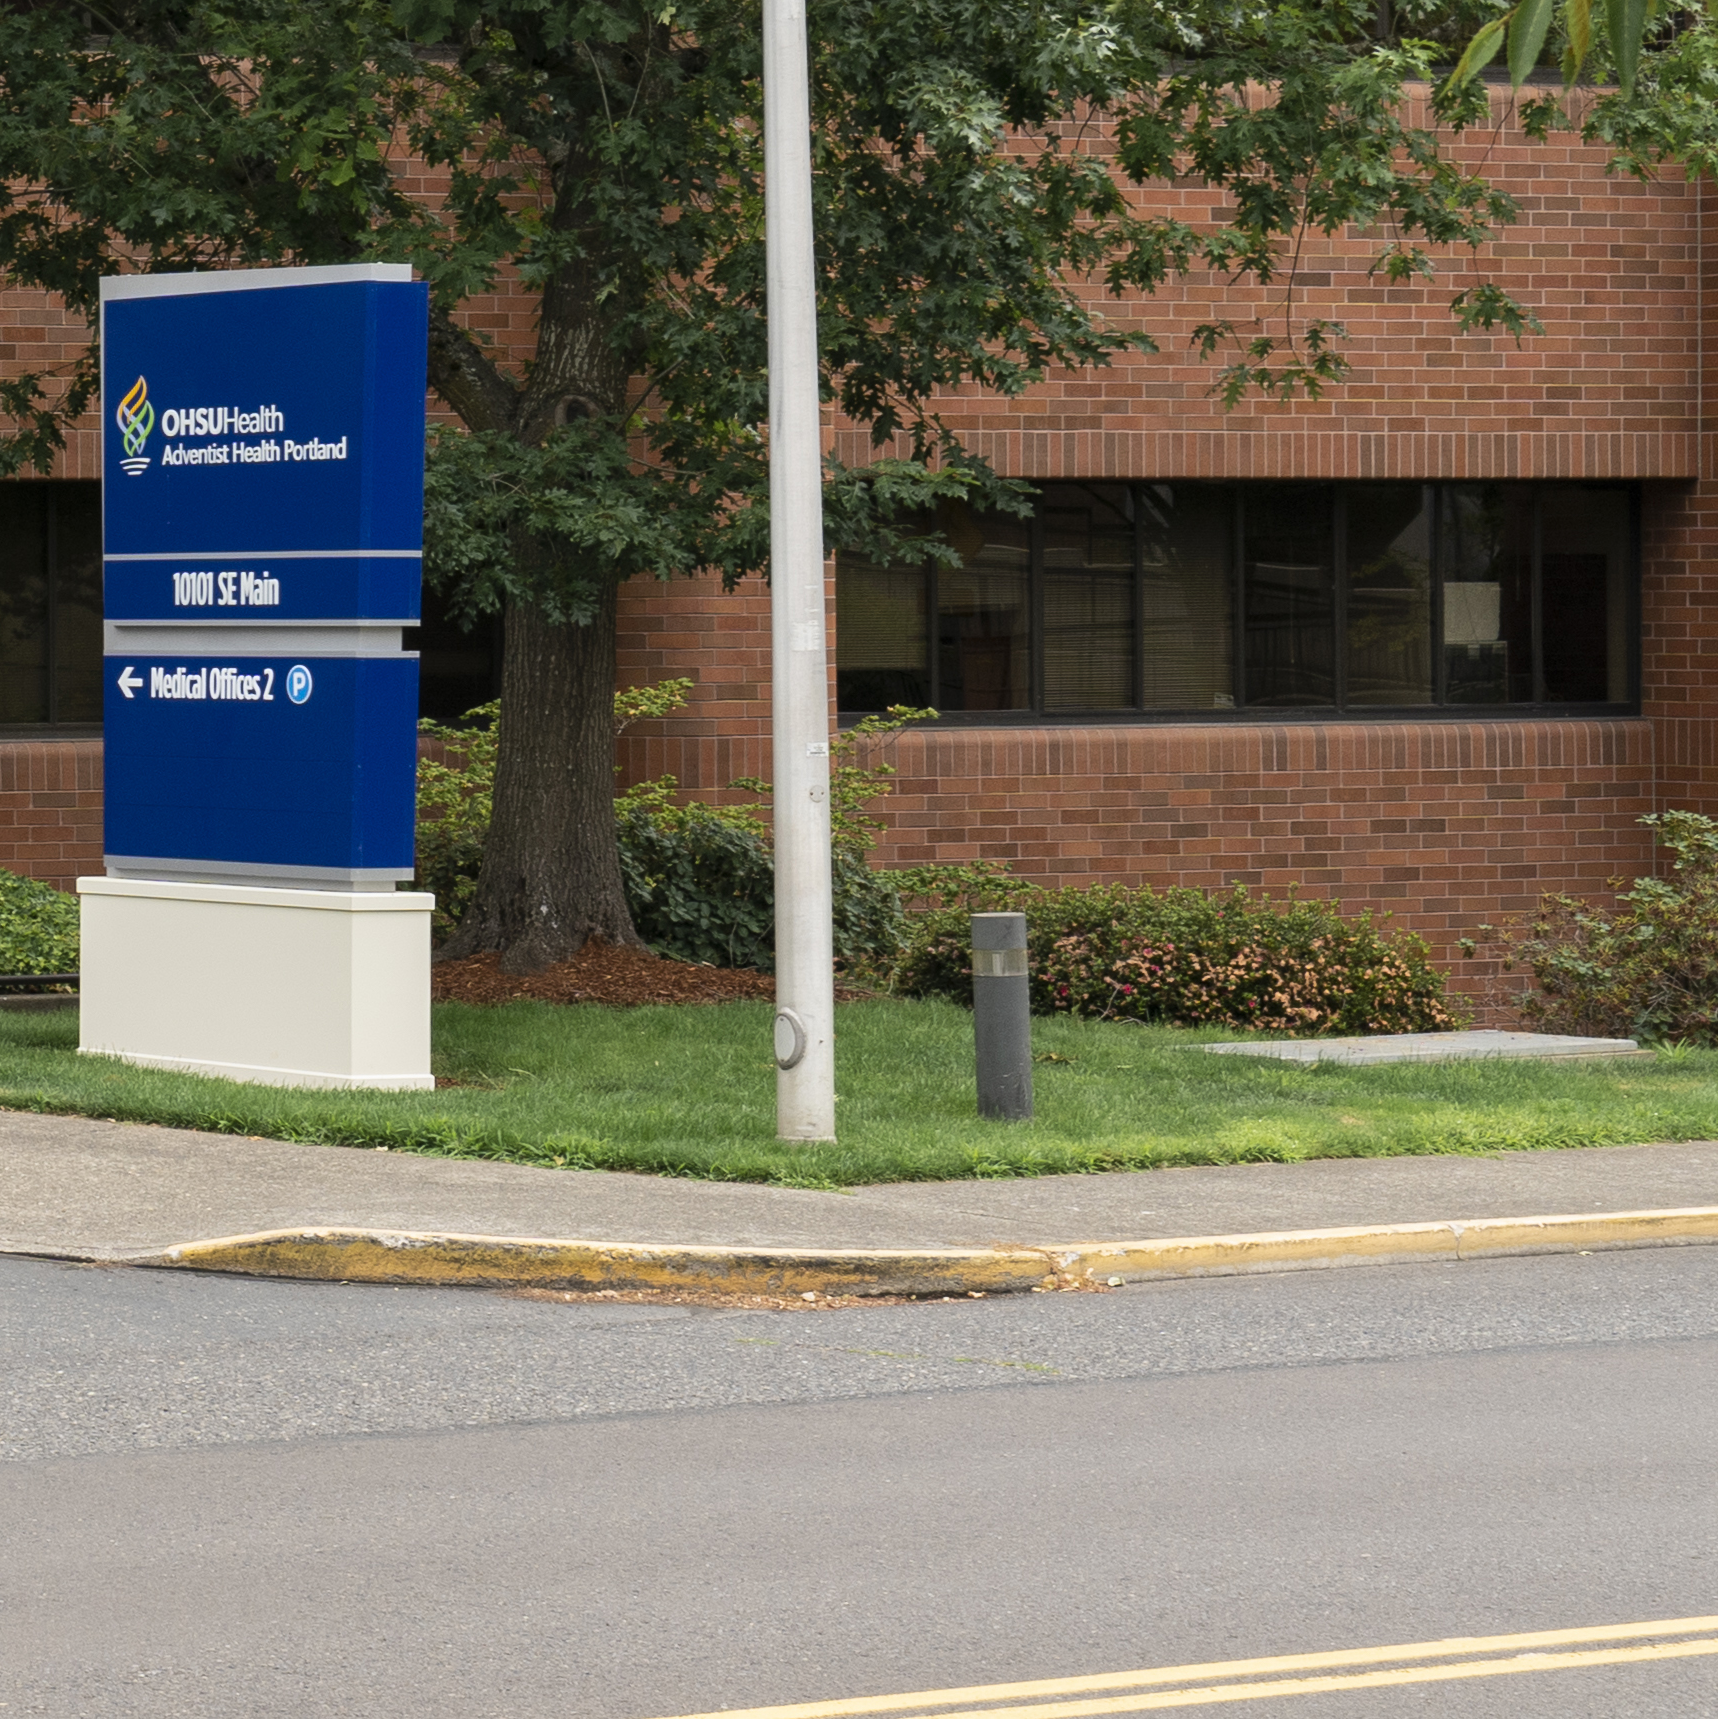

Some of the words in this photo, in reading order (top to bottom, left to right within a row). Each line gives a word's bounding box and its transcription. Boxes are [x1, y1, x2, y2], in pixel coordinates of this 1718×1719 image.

[161, 443, 230, 466] Adventist
[232, 439, 281, 463] Health
[284, 436, 348, 462] Portland
[172, 571, 214, 606] 10101
[217, 571, 238, 606] SE
[240, 570, 280, 606] Main
[150, 666, 208, 699] Medical
[209, 667, 261, 700] Offices
[262, 668, 275, 701] 2
